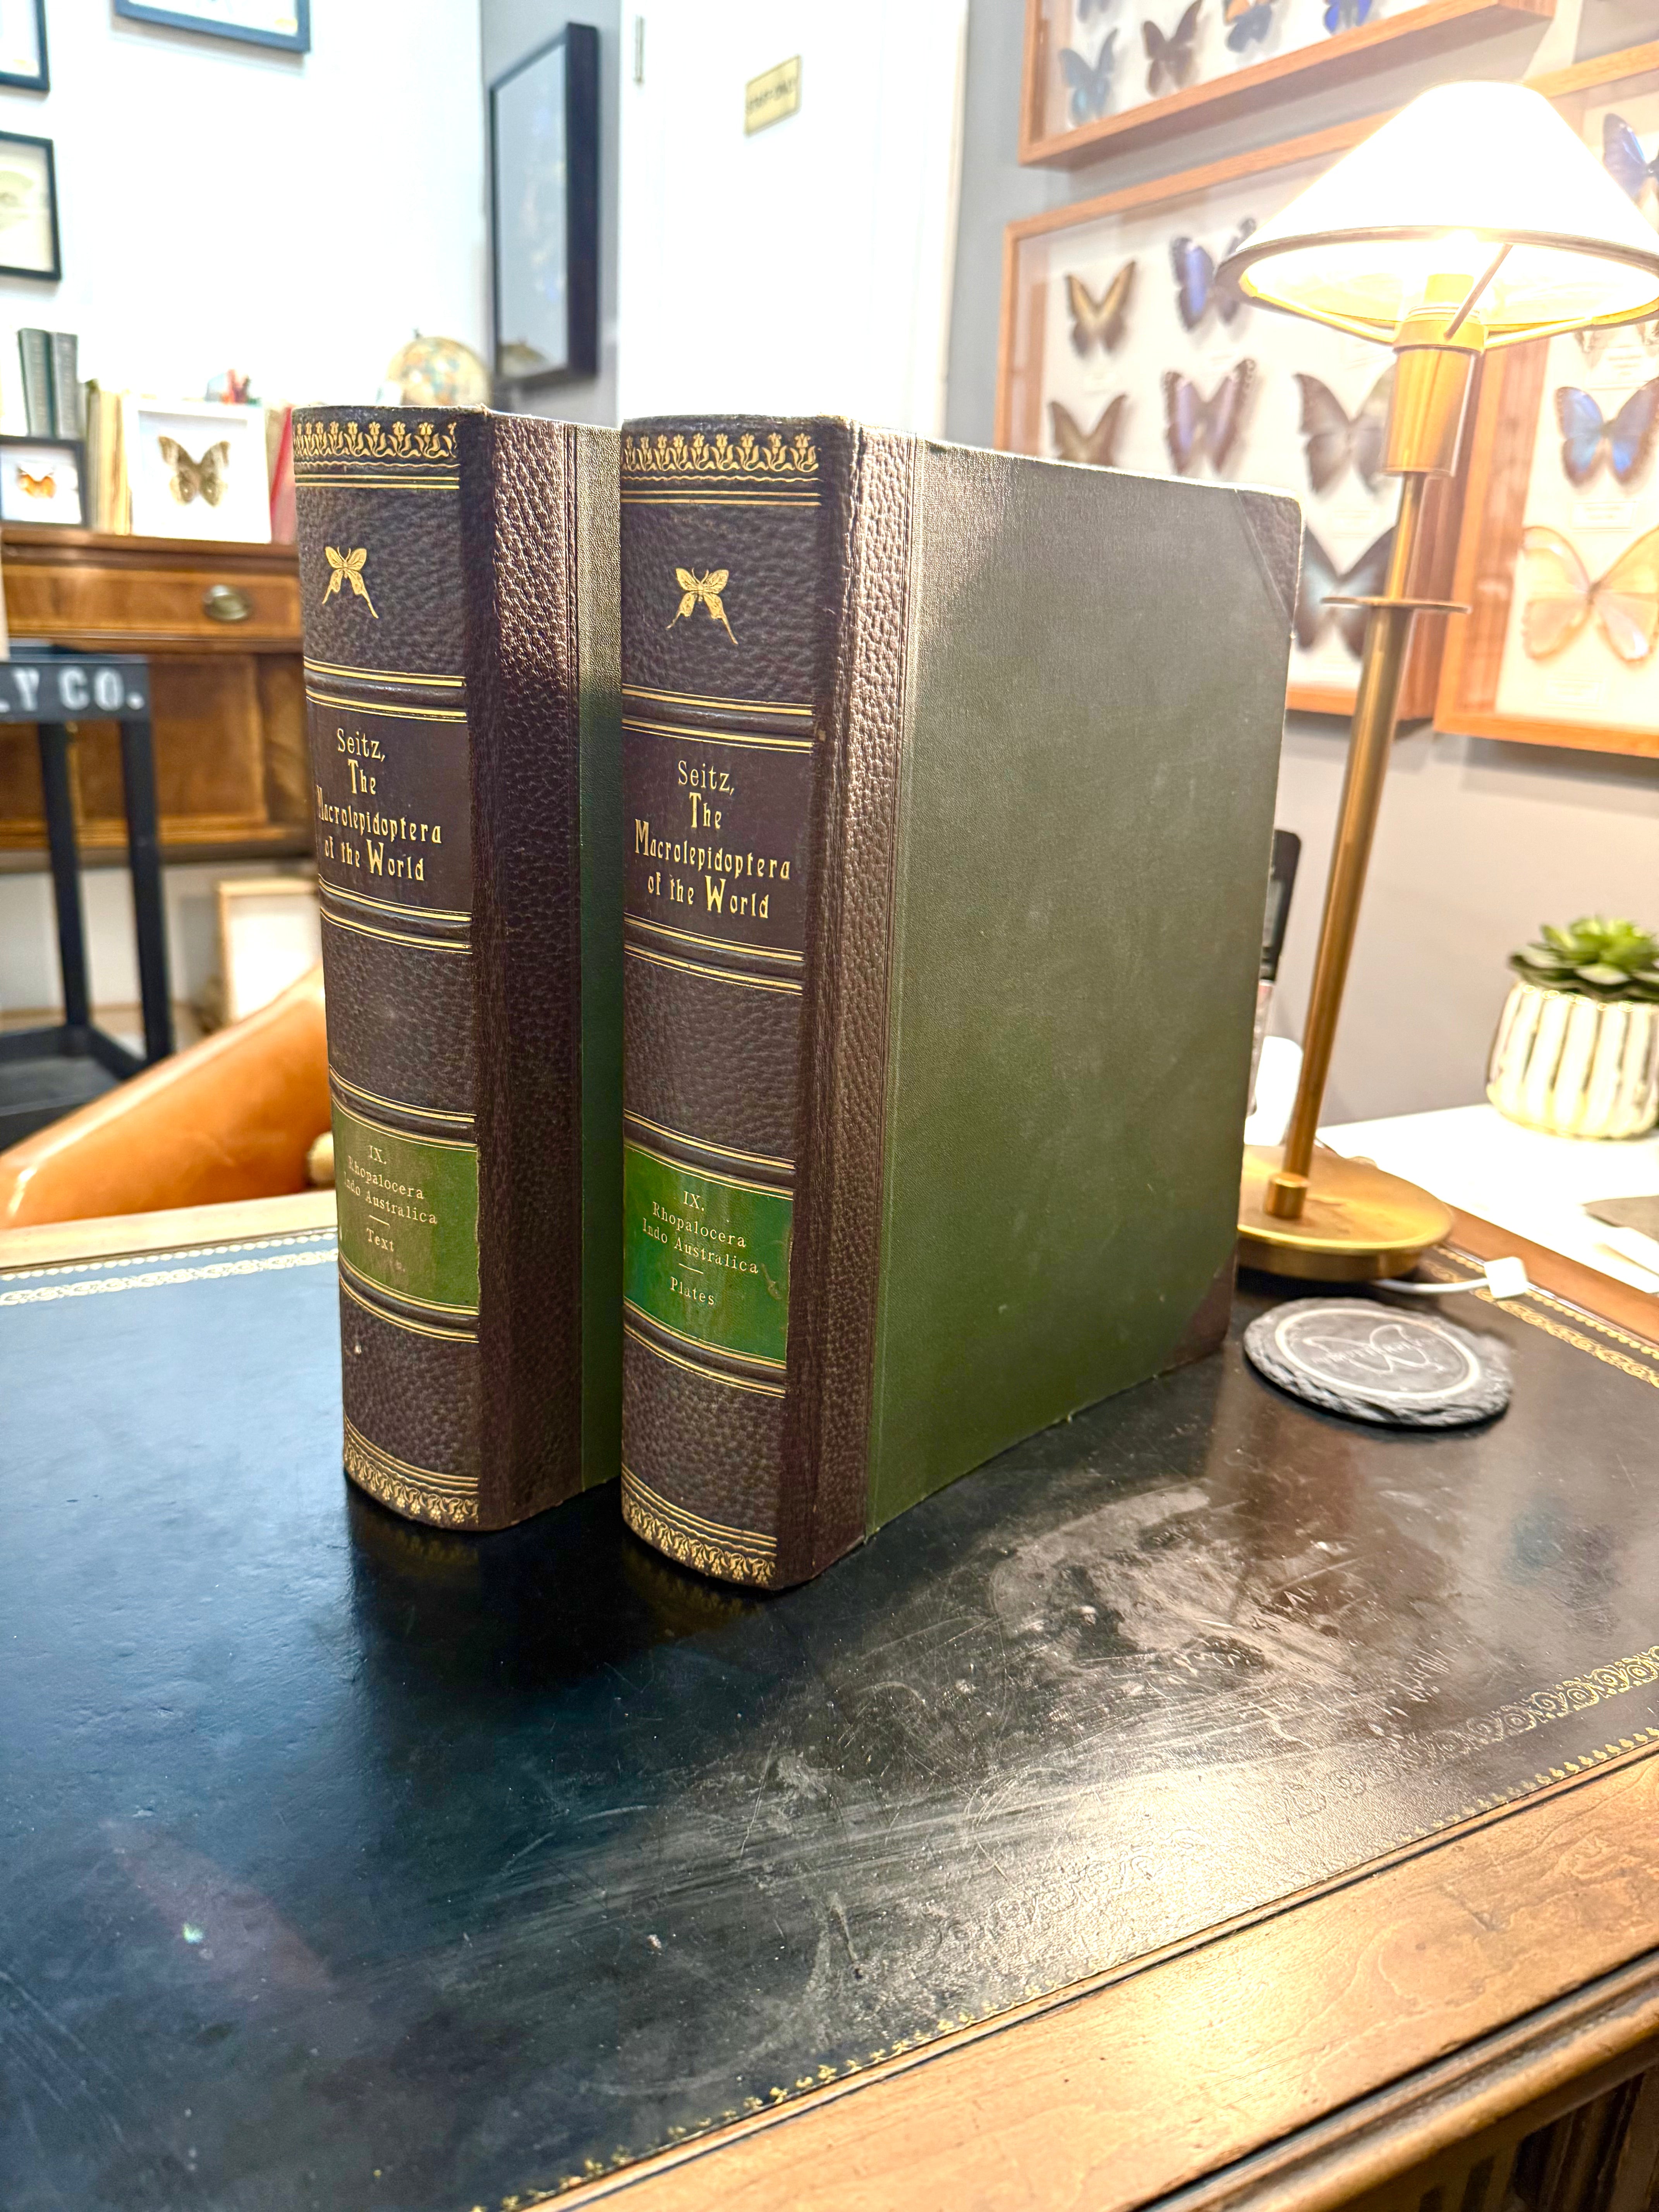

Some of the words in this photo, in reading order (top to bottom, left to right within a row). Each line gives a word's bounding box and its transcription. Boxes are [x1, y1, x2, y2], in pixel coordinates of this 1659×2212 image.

[59, 666, 144, 711] CO.
[337, 728, 385, 762] Seitz,
[348, 759, 376, 794] The
[678, 760, 734, 795] Seitz,
[316, 785, 441, 843] Macrolepidoptera
[689, 792, 721, 829] The
[325, 836, 334, 859] of
[341, 842, 360, 867] the
[367, 839, 424, 881] World
[635, 819, 790, 879] Macrolepidoptera
[648, 872, 661, 895] of
[670, 874, 694, 905] the
[705, 876, 769, 919] World
[368, 1145, 386, 1164] IX.
[344, 1171, 360, 1196] Indo
[365, 1190, 437, 1224] Australica
[348, 1156, 424, 1199] Rhopalocera
[683, 1191, 704, 1211] IX.
[366, 1228, 394, 1252] Text
[643, 1218, 667, 1243] Indo
[674, 1237, 758, 1274] Australica
[653, 1202, 746, 1248] Rhopalocera
[671, 1276, 714, 1305] Plates
